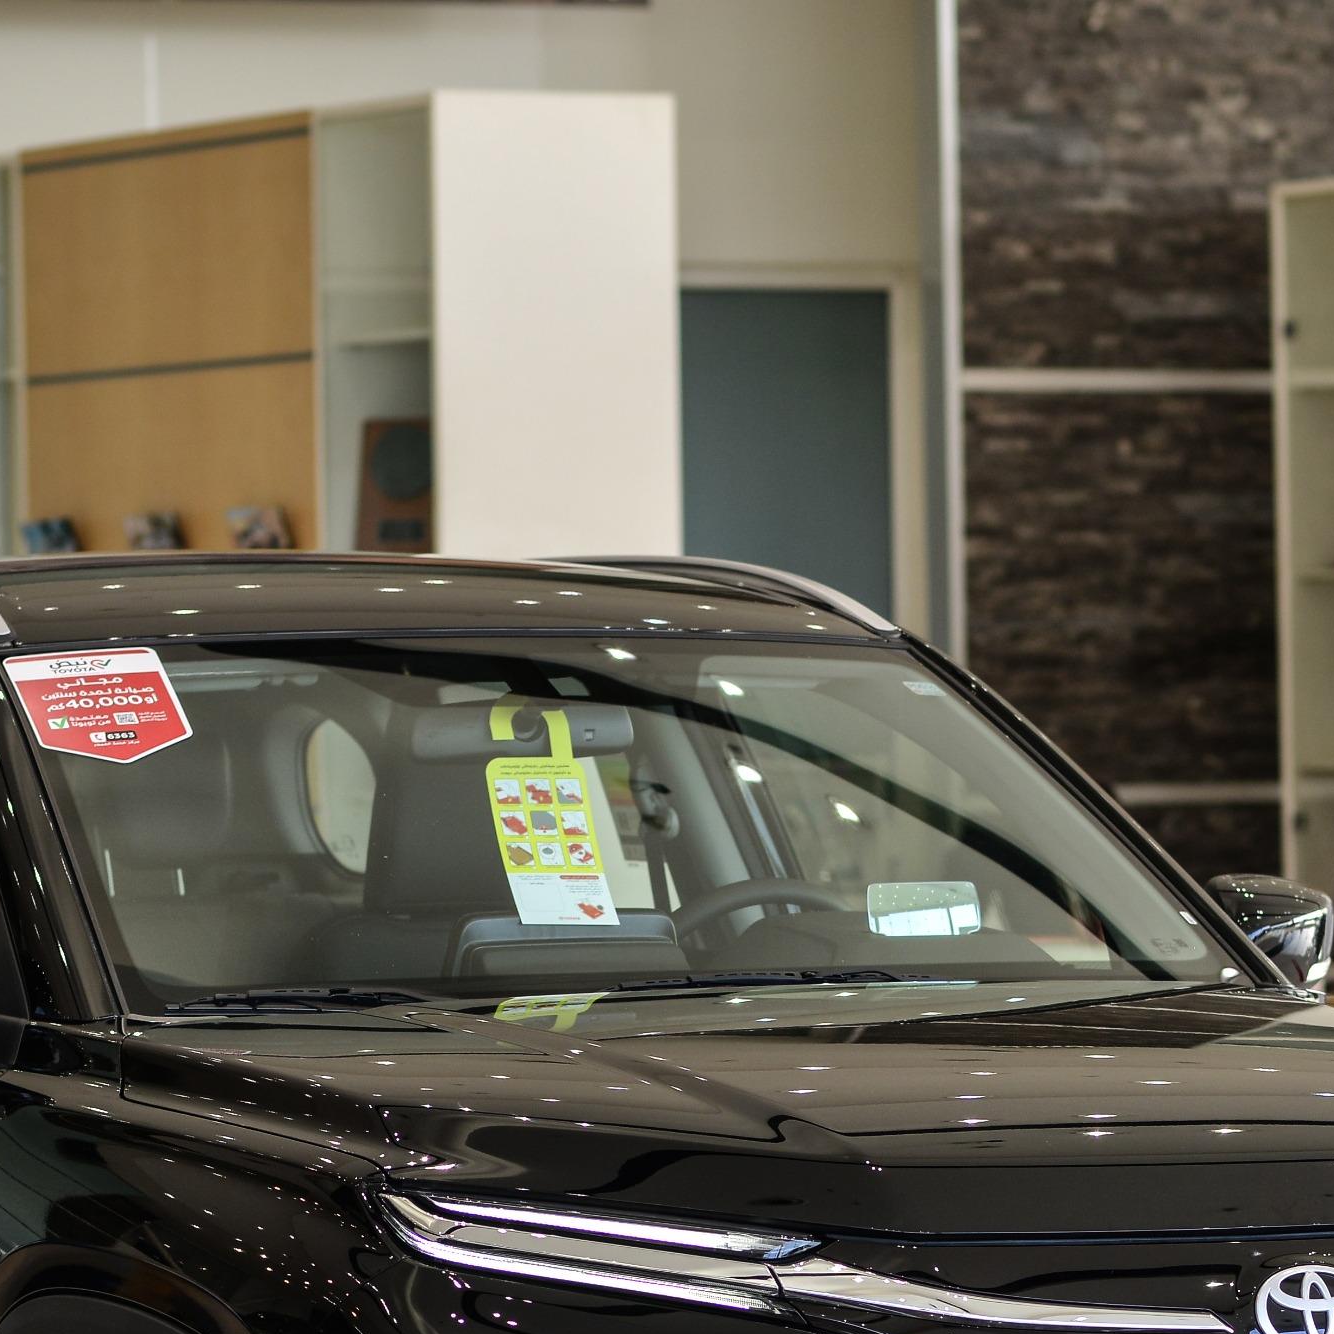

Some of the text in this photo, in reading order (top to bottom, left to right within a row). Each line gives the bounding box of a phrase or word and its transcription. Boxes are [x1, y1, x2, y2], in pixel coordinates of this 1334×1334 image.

[49, 658, 87, 670] نبض
[53, 667, 96, 675] TOYOTA
[56, 676, 123, 690] مجاني
[66, 694, 143, 710] 40,000
[107, 732, 135, 740] 6363
